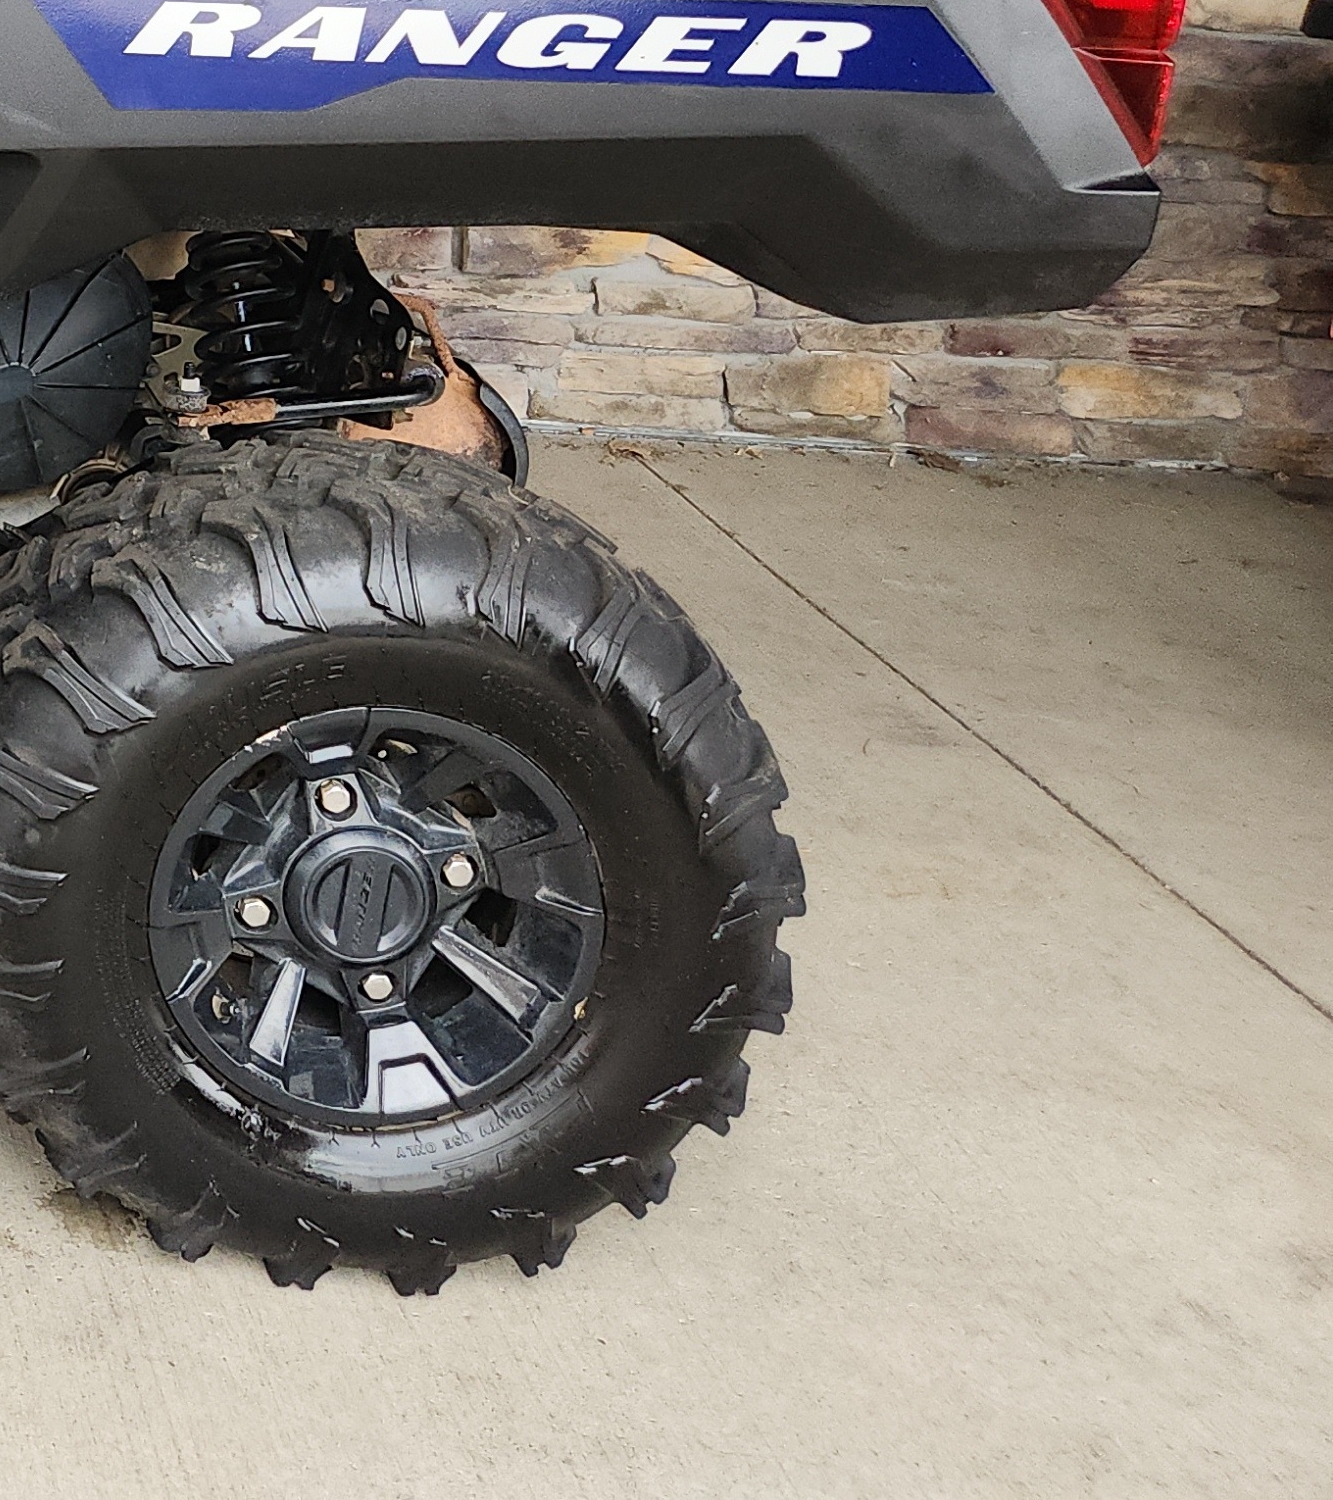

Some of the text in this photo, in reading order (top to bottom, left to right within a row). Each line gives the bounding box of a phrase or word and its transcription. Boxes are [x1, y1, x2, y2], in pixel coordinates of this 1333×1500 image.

[121, 0, 873, 79] RANGER
[442, 1132, 473, 1150] USE
[396, 1143, 437, 1159] ONLY
